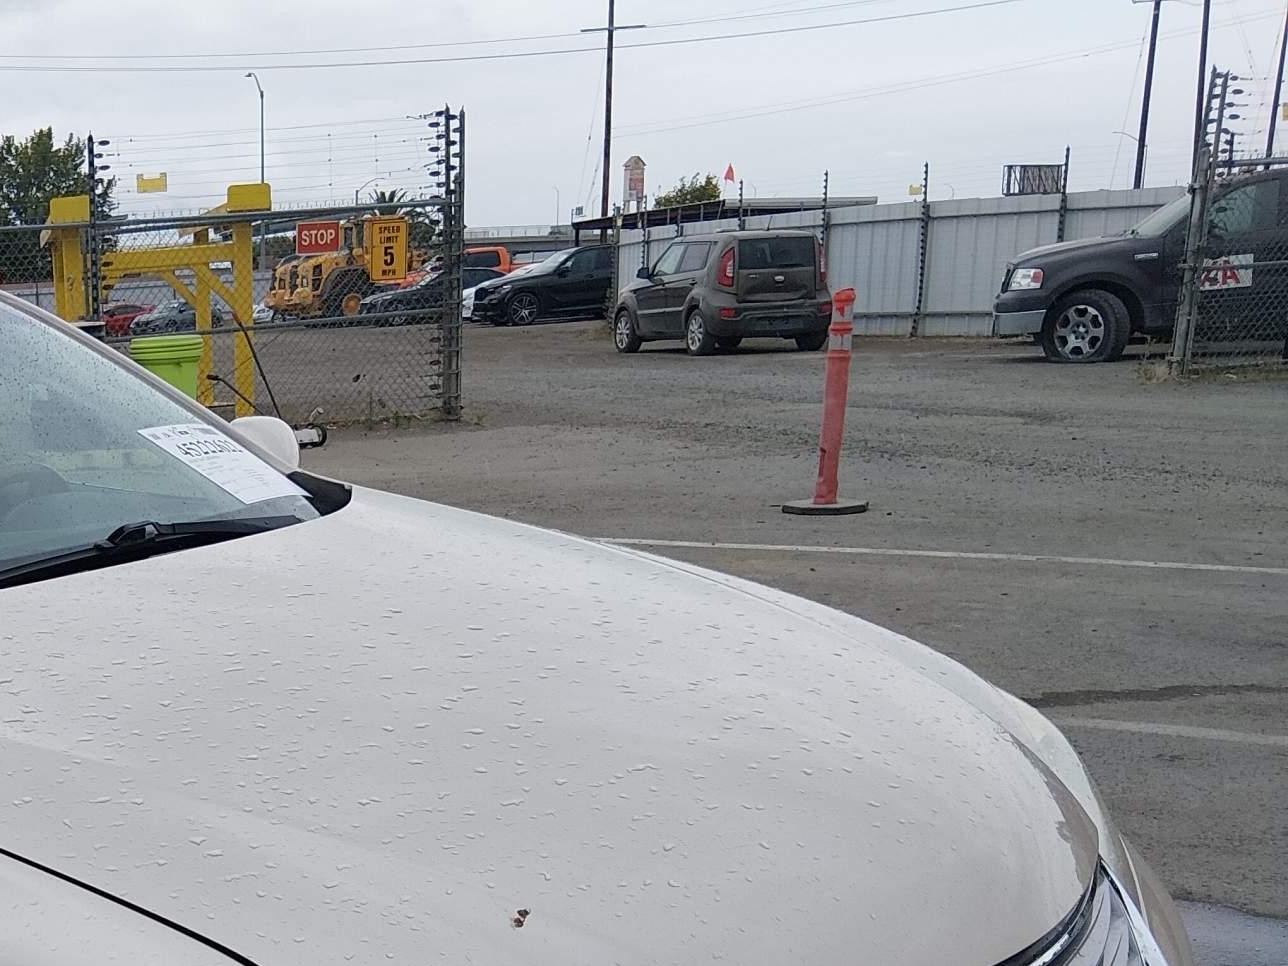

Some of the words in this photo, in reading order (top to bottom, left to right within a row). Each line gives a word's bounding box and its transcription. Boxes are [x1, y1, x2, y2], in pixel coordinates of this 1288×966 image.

[378, 225, 401, 234] SPEED
[301, 229, 336, 246] STOP
[379, 236, 400, 244] LIMIT
[383, 246, 395, 267] 5
[381, 269, 397, 277] MPH
